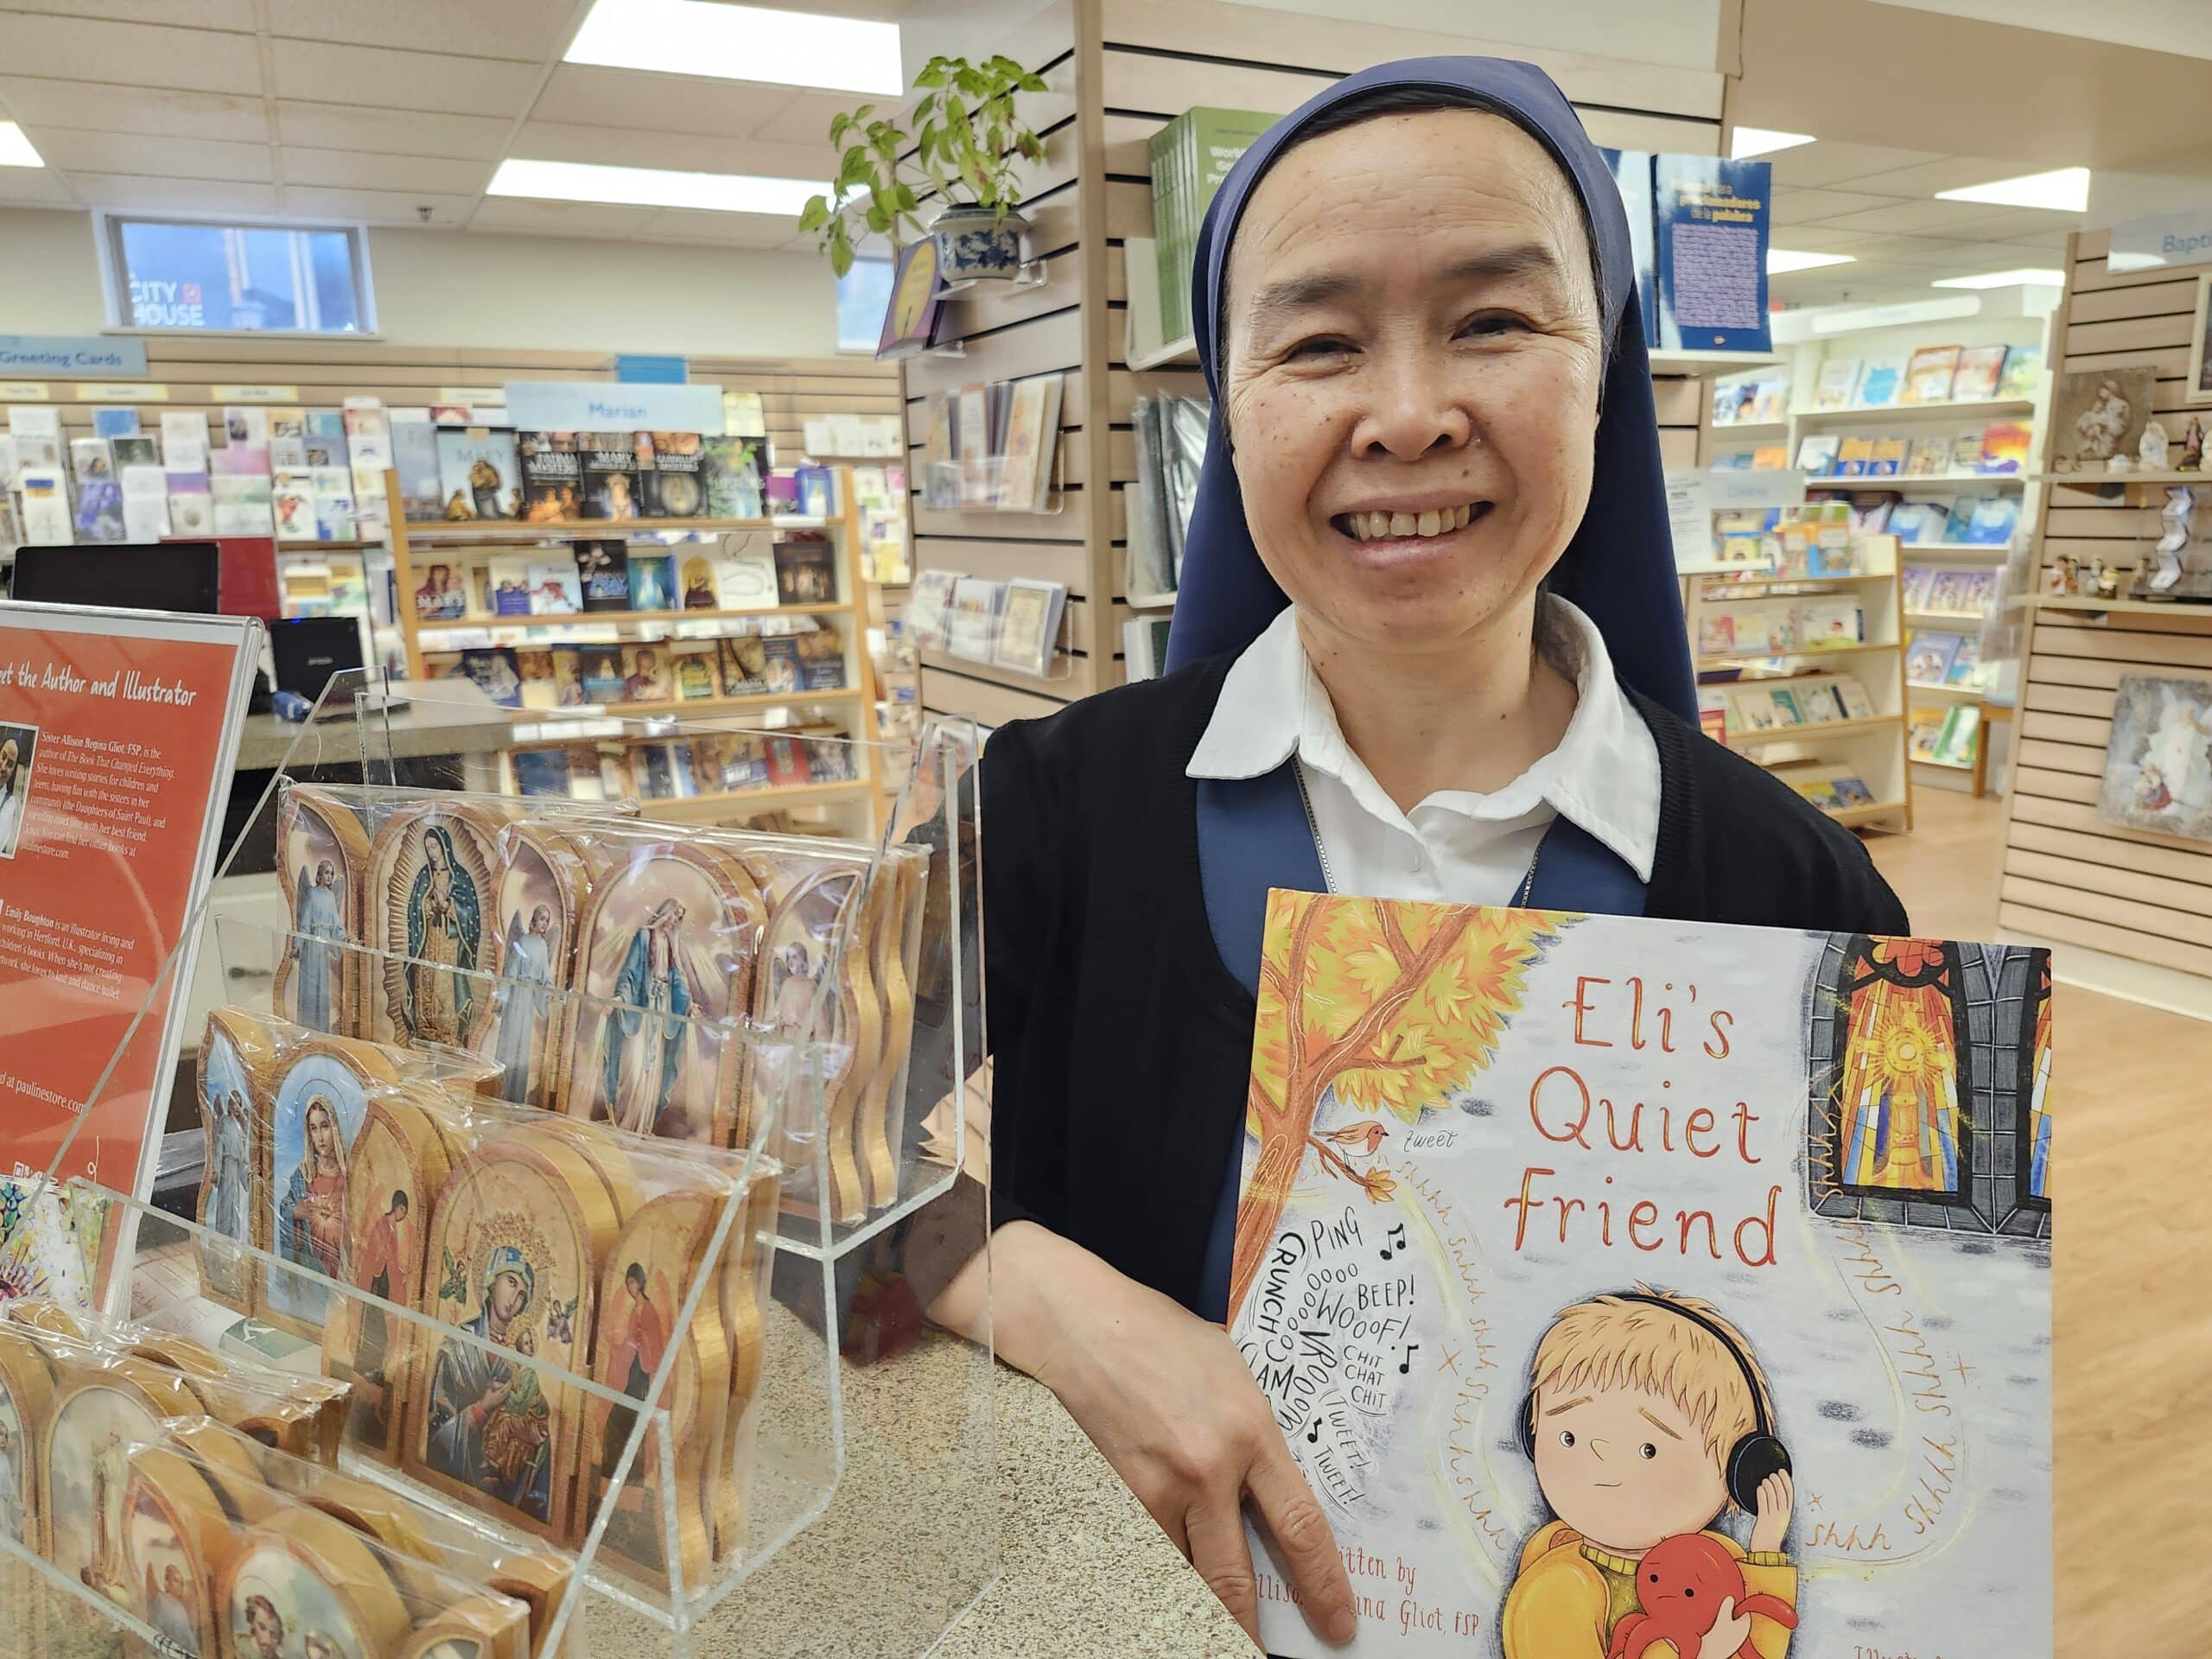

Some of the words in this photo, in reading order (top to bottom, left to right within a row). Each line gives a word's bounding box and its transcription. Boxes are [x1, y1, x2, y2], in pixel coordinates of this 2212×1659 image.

[130, 281, 177, 303] CITY
[134, 303, 205, 326] HOUSE
[0, 351, 71, 368] Greeting
[75, 351, 122, 365] Cards
[589, 401, 648, 419] Marian
[18, 659, 37, 688] the
[41, 662, 86, 693] Author
[91, 671, 120, 698] and
[123, 671, 197, 706] Illustrator
[39, 748, 58, 760] author
[67, 751, 79, 763] The
[79, 753, 95, 766] Book
[41, 732, 61, 743] Sister
[61, 734, 84, 747] Allison
[85, 737, 107, 752] Regina
[150, 747, 162, 760] the
[36, 762, 48, 774] She
[48, 765, 64, 777] loves
[65, 768, 86, 783] writing
[87, 772, 108, 785] stories
[109, 774, 119, 786] for
[119, 776, 145, 791] children
[145, 782, 159, 793] and
[51, 781, 72, 796] having
[72, 785, 83, 795] fun
[84, 787, 98, 798] with
[99, 789, 110, 801] the
[110, 792, 130, 804] sisters
[138, 796, 150, 808] her
[76, 801, 107, 817] Daughters
[117, 809, 134, 822] Saint
[153, 817, 167, 830] and
[99, 823, 111, 835] her
[111, 825, 125, 837] best
[5, 906, 22, 922] Emily
[23, 910, 54, 927] Boughton
[70, 924, 102, 941] illustrator
[101, 931, 120, 948] living
[120, 938, 135, 950] and
[48, 950, 67, 965] When
[84, 963, 95, 975] not
[1562, 976, 1733, 1059] Eli's
[7, 1076, 15, 1090] at
[1529, 1066, 1762, 1165] Quiet
[1403, 1129, 1459, 1153] tweet
[1311, 1205, 1363, 1259] PING
[1257, 1231, 1306, 1335] CRUNCH
[1358, 1273, 1414, 1310] BEEP!
[1317, 1287, 1412, 1351] WOOOF!
[1344, 1344, 1383, 1368] CHIT
[1345, 1363, 1385, 1387] CHAT
[1351, 1385, 1387, 1409] CHIT
[1325, 1395, 1371, 1469] TWEET!
[1313, 1444, 1366, 1505] TWEET!
[1338, 1546, 1386, 1580] itten
[1396, 1556, 1416, 1596] by
[1255, 1573, 1303, 1605] lliso
[1400, 1599, 1446, 1637] Gliot,
[1454, 1610, 1480, 1637] FSP
